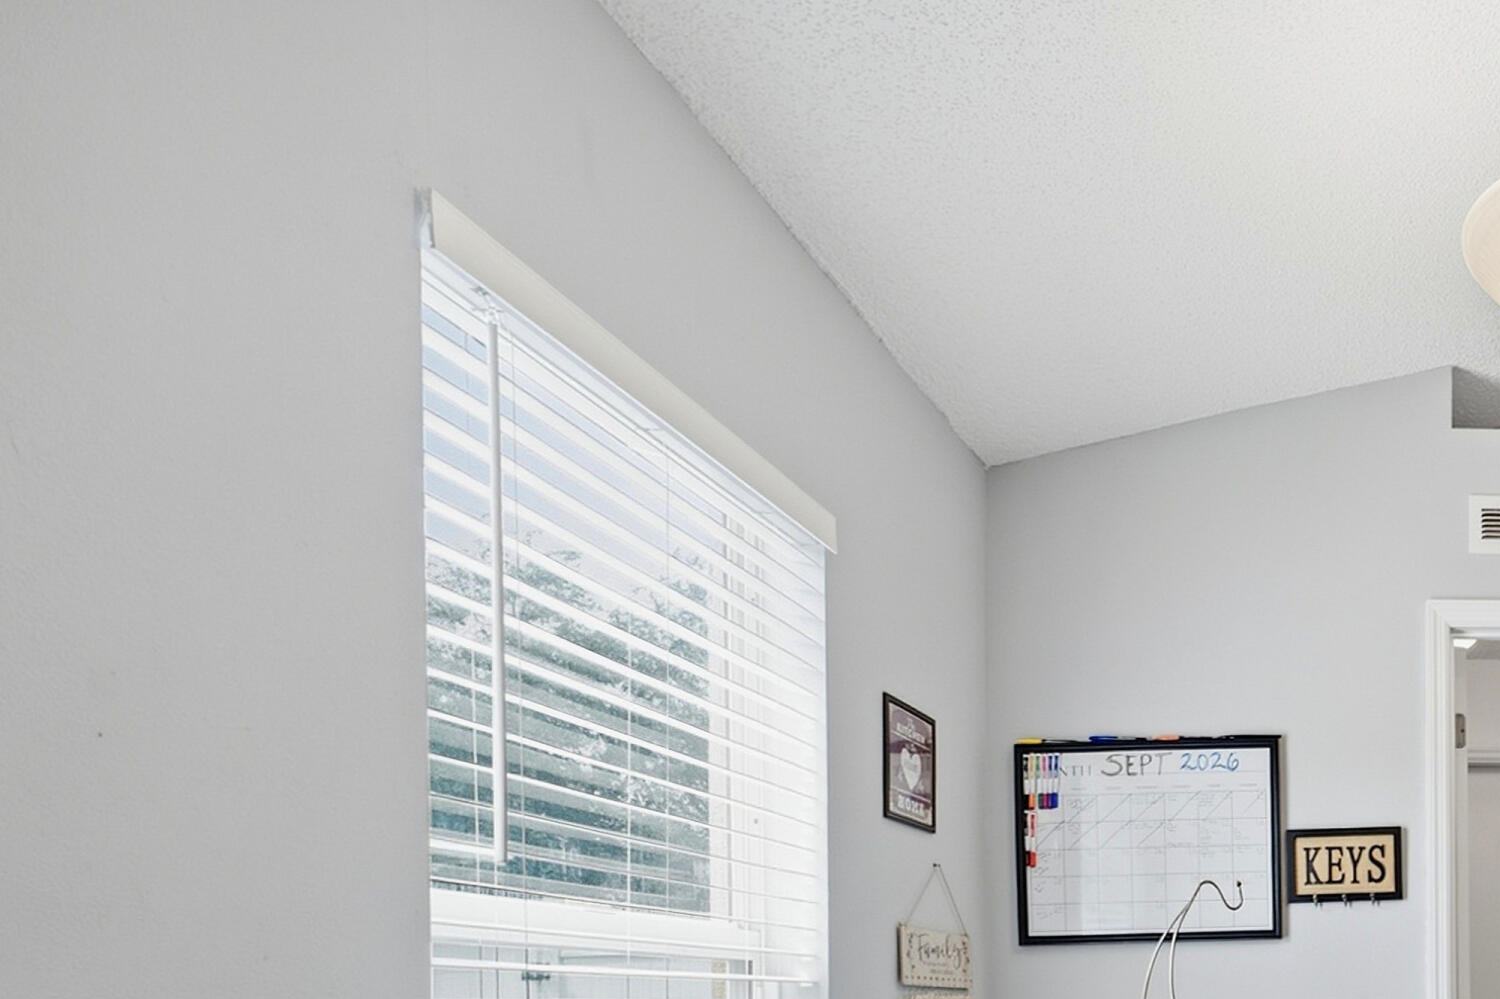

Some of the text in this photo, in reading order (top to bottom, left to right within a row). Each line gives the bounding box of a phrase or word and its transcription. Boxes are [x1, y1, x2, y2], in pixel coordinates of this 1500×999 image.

[1101, 751, 1240, 777] SEPT 2026
[1303, 844, 1387, 886] KEYS
